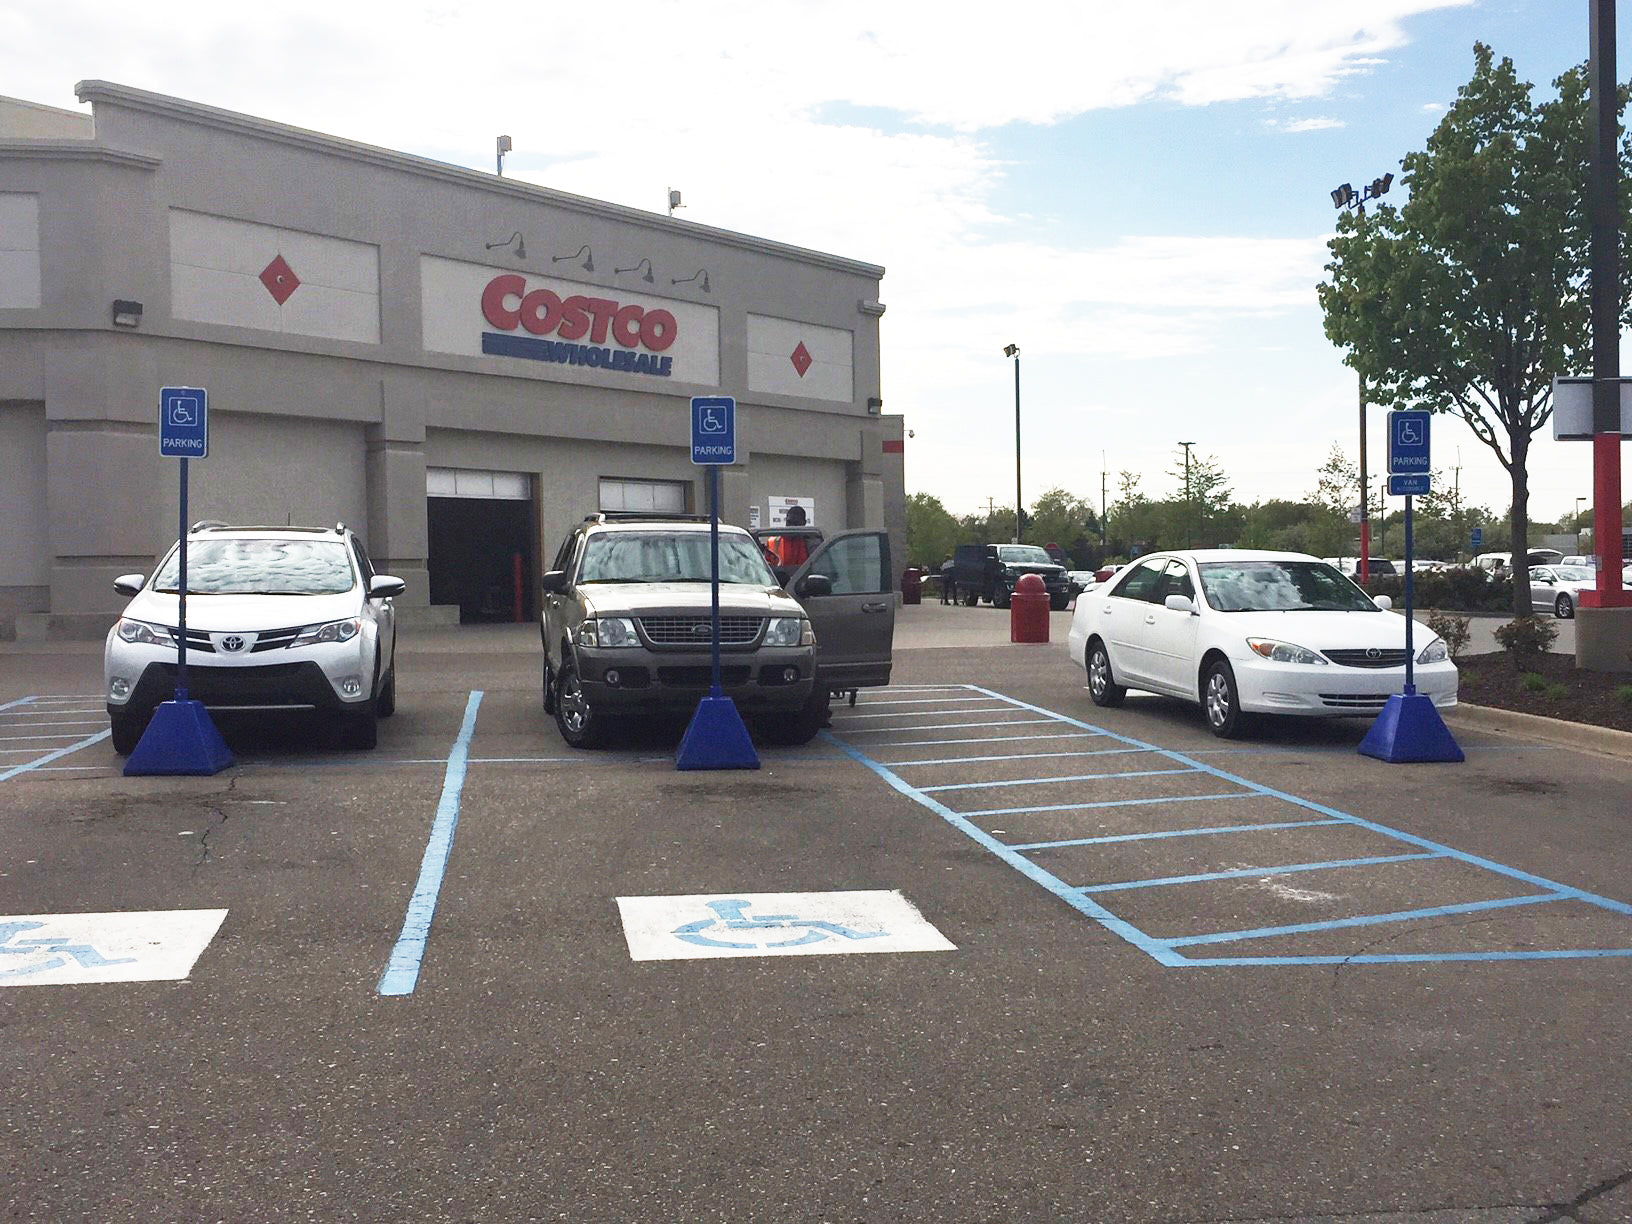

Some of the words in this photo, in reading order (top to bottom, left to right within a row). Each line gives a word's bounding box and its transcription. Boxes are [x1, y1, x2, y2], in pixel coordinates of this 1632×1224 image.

[481, 274, 678, 352] COSTCO
[548, 340, 673, 377] WHOLESALE
[163, 438, 203, 449] PARKING
[694, 446, 732, 456] PARKING
[1393, 456, 1428, 466] PARKING
